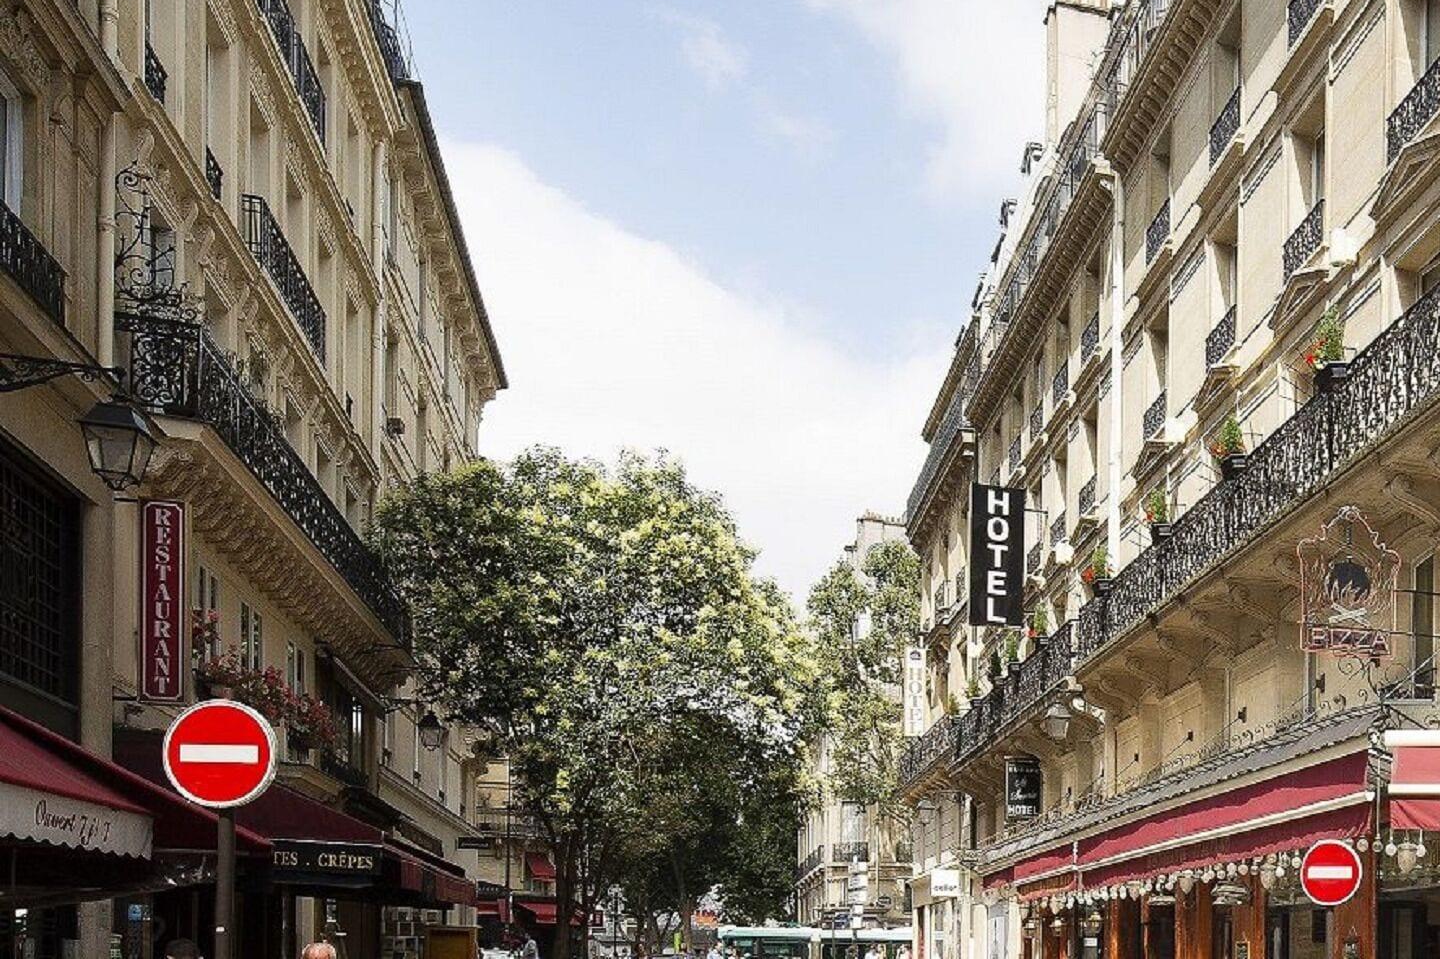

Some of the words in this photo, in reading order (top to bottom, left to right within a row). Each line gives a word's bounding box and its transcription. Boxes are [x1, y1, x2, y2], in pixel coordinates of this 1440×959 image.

[986, 489, 1010, 624] HOTEL
[153, 507, 172, 695] RESTAURANT
[1008, 804, 1039, 816] HOTEL
[318, 851, 373, 869] CRÊPES
